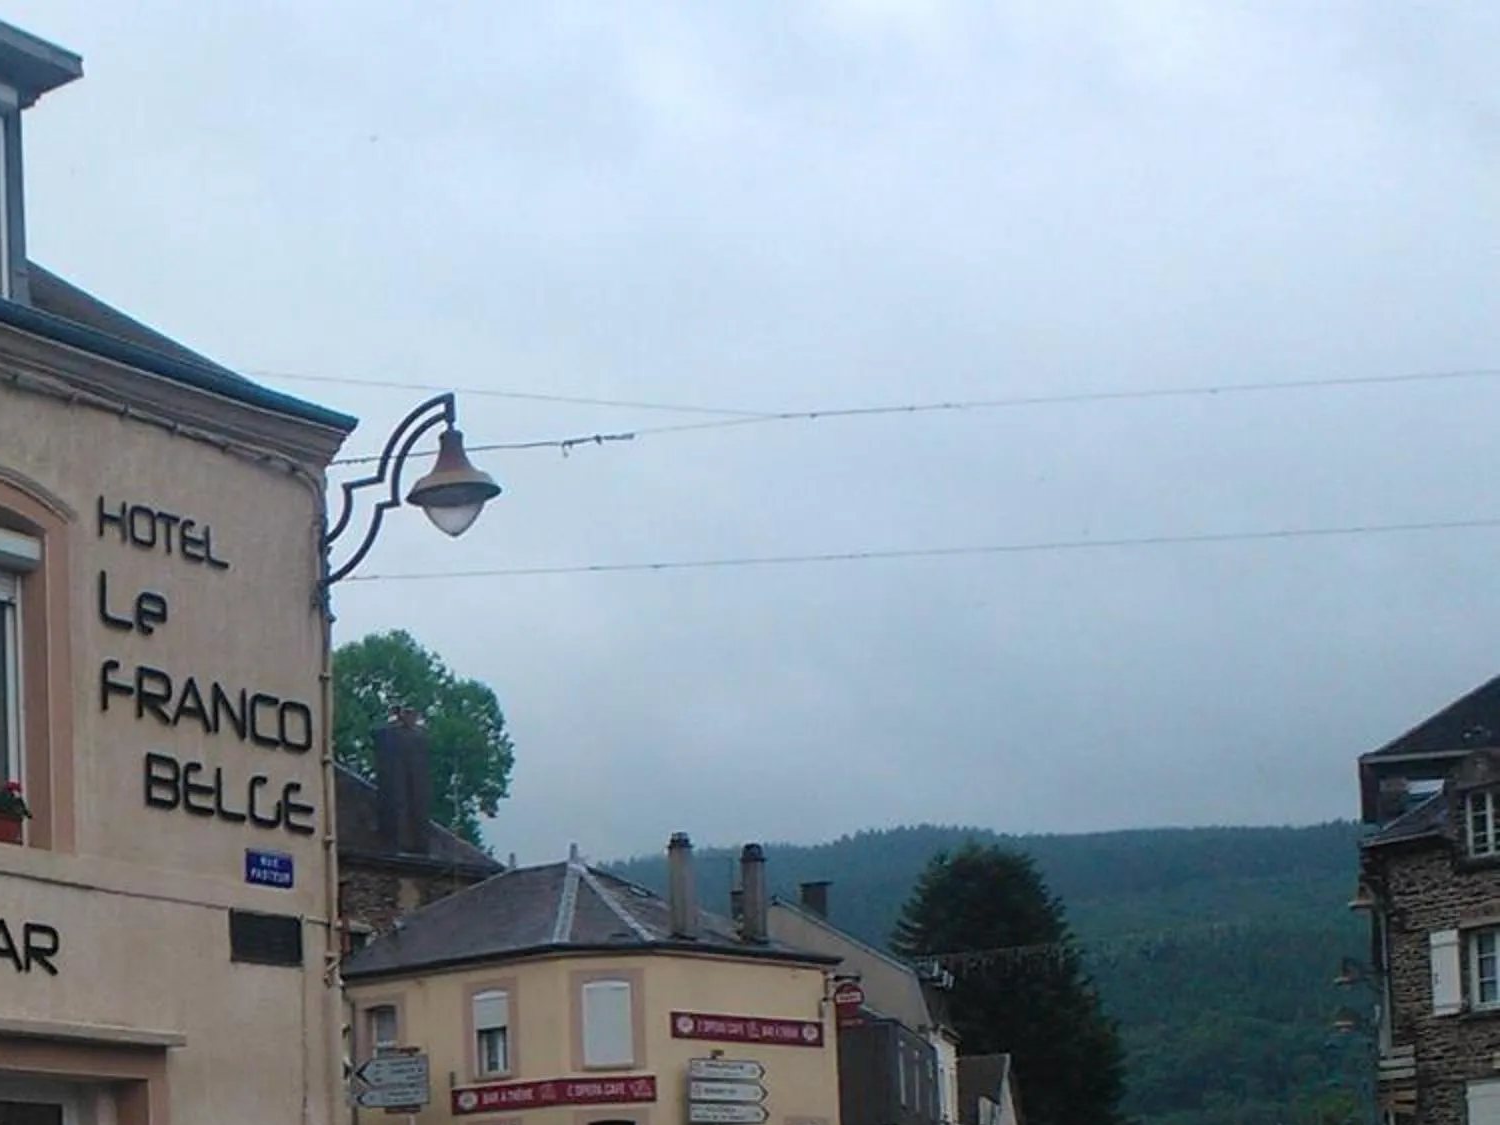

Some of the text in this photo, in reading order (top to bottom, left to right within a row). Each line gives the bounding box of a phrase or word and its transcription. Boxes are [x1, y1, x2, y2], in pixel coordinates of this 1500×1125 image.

[99, 496, 229, 569] HOTEL
[99, 570, 168, 635] Le
[100, 659, 314, 753] FRANCO
[144, 751, 316, 835] BELGE
